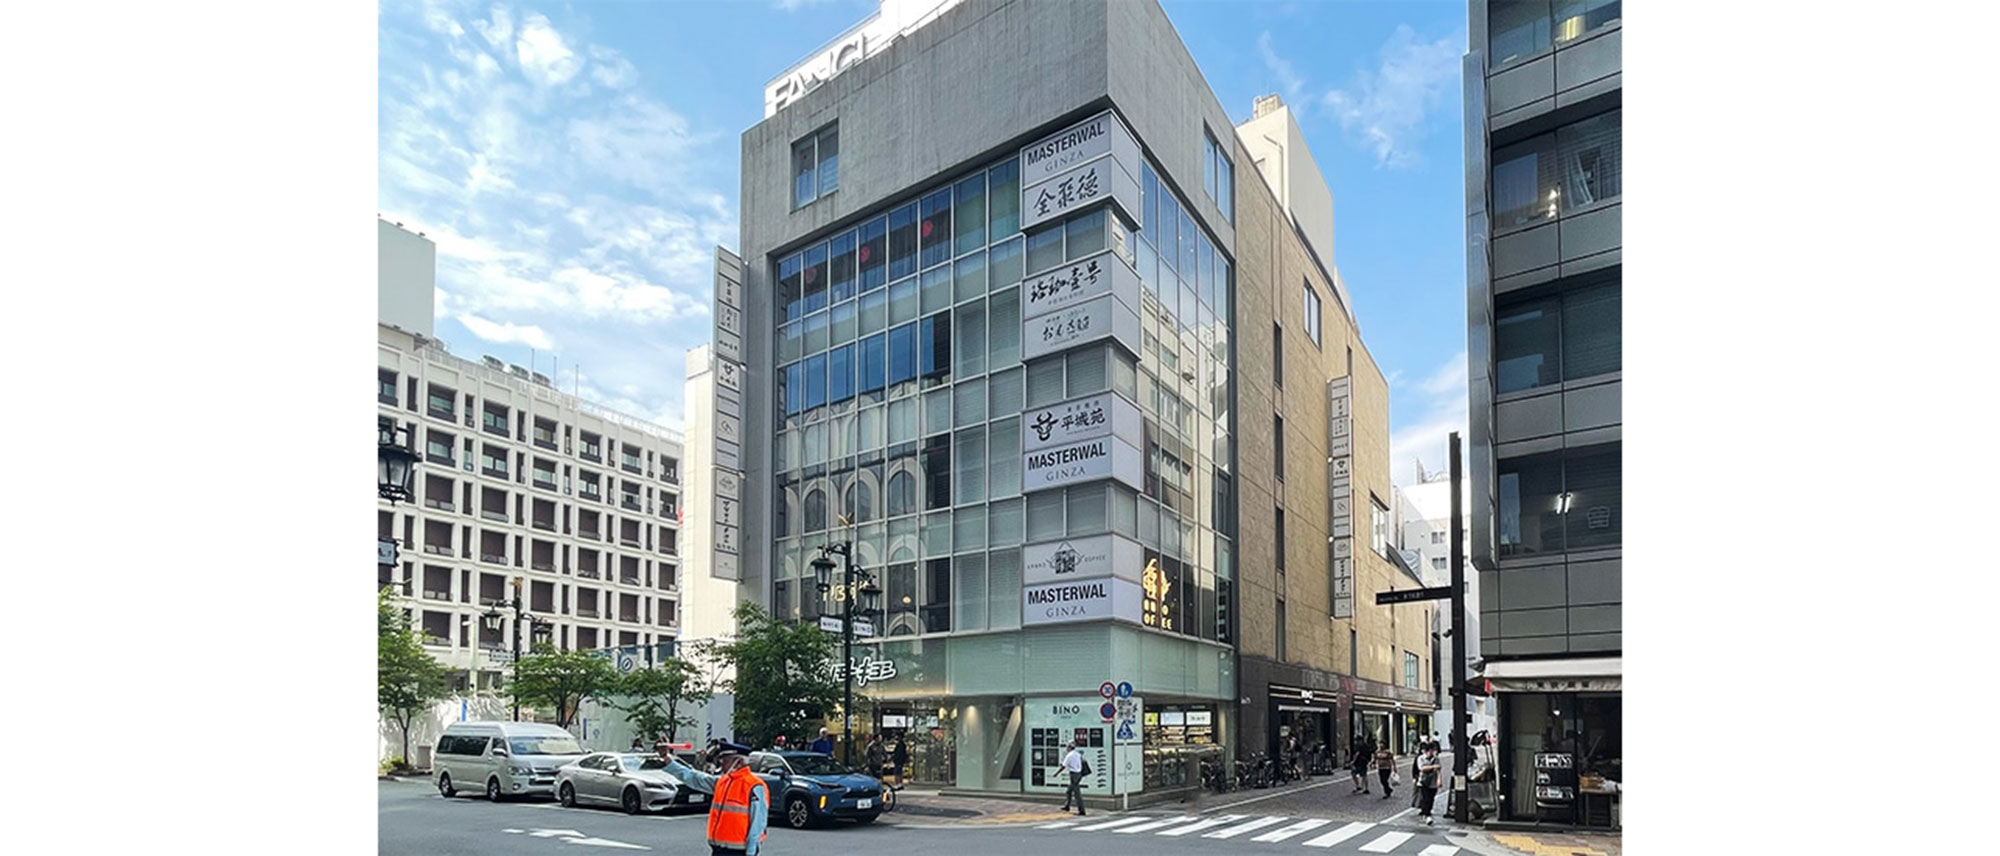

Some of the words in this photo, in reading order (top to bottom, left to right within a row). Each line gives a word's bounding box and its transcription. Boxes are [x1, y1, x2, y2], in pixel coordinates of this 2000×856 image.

[1027, 121, 1105, 166] MASTERWAL
[1045, 150, 1085, 173] GINZA
[1061, 407, 1106, 431] 平城苑
[1028, 442, 1107, 471] MASTERWAL
[1046, 466, 1086, 481] GINZA
[1028, 583, 1107, 605] MASTERWAL
[1045, 605, 1086, 618] GINZA
[1052, 704, 1080, 715] BINO
